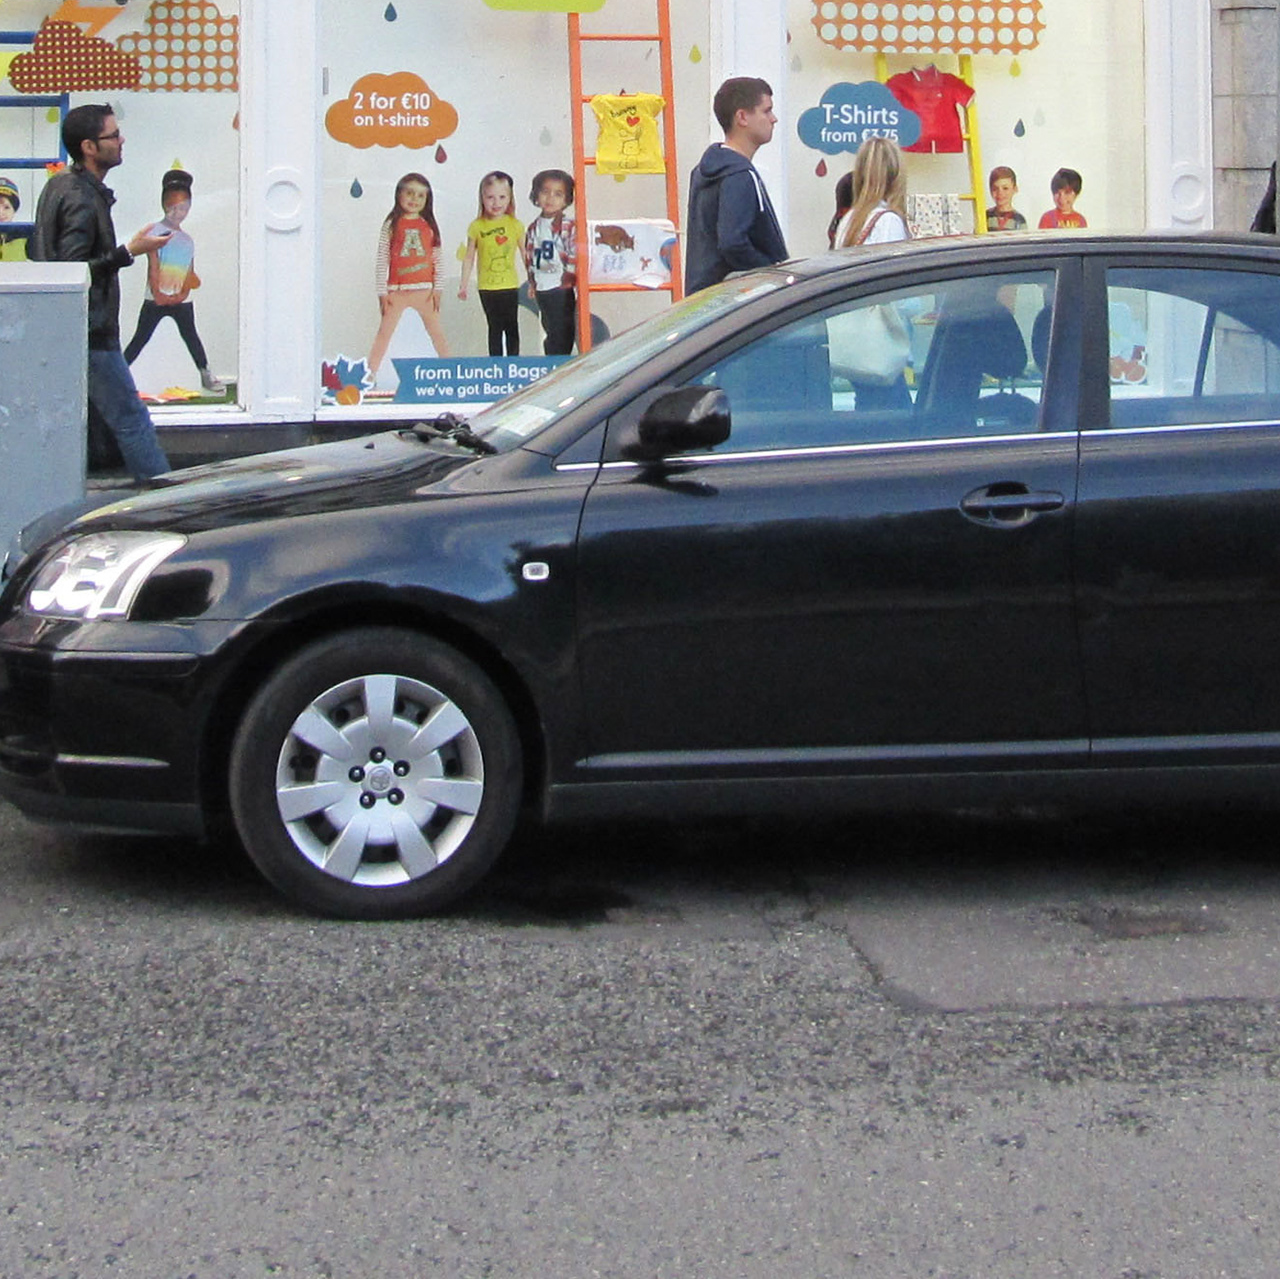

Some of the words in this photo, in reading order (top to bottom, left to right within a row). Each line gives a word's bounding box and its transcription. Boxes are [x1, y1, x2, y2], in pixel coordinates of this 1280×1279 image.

[354, 92, 364, 110] 2
[370, 92, 397, 110] for
[401, 92, 431, 110] €10
[354, 114, 374, 127] on
[378, 112, 430, 127] t-shirts
[822, 103, 899, 126] T-Shirts
[821, 126, 857, 143] from
[414, 365, 452, 381] from
[456, 364, 504, 380] Lunch
[508, 364, 548, 382] Bags
[415, 383, 454, 397] we've
[457, 384, 480, 399] got
[483, 382, 515, 396] Back
